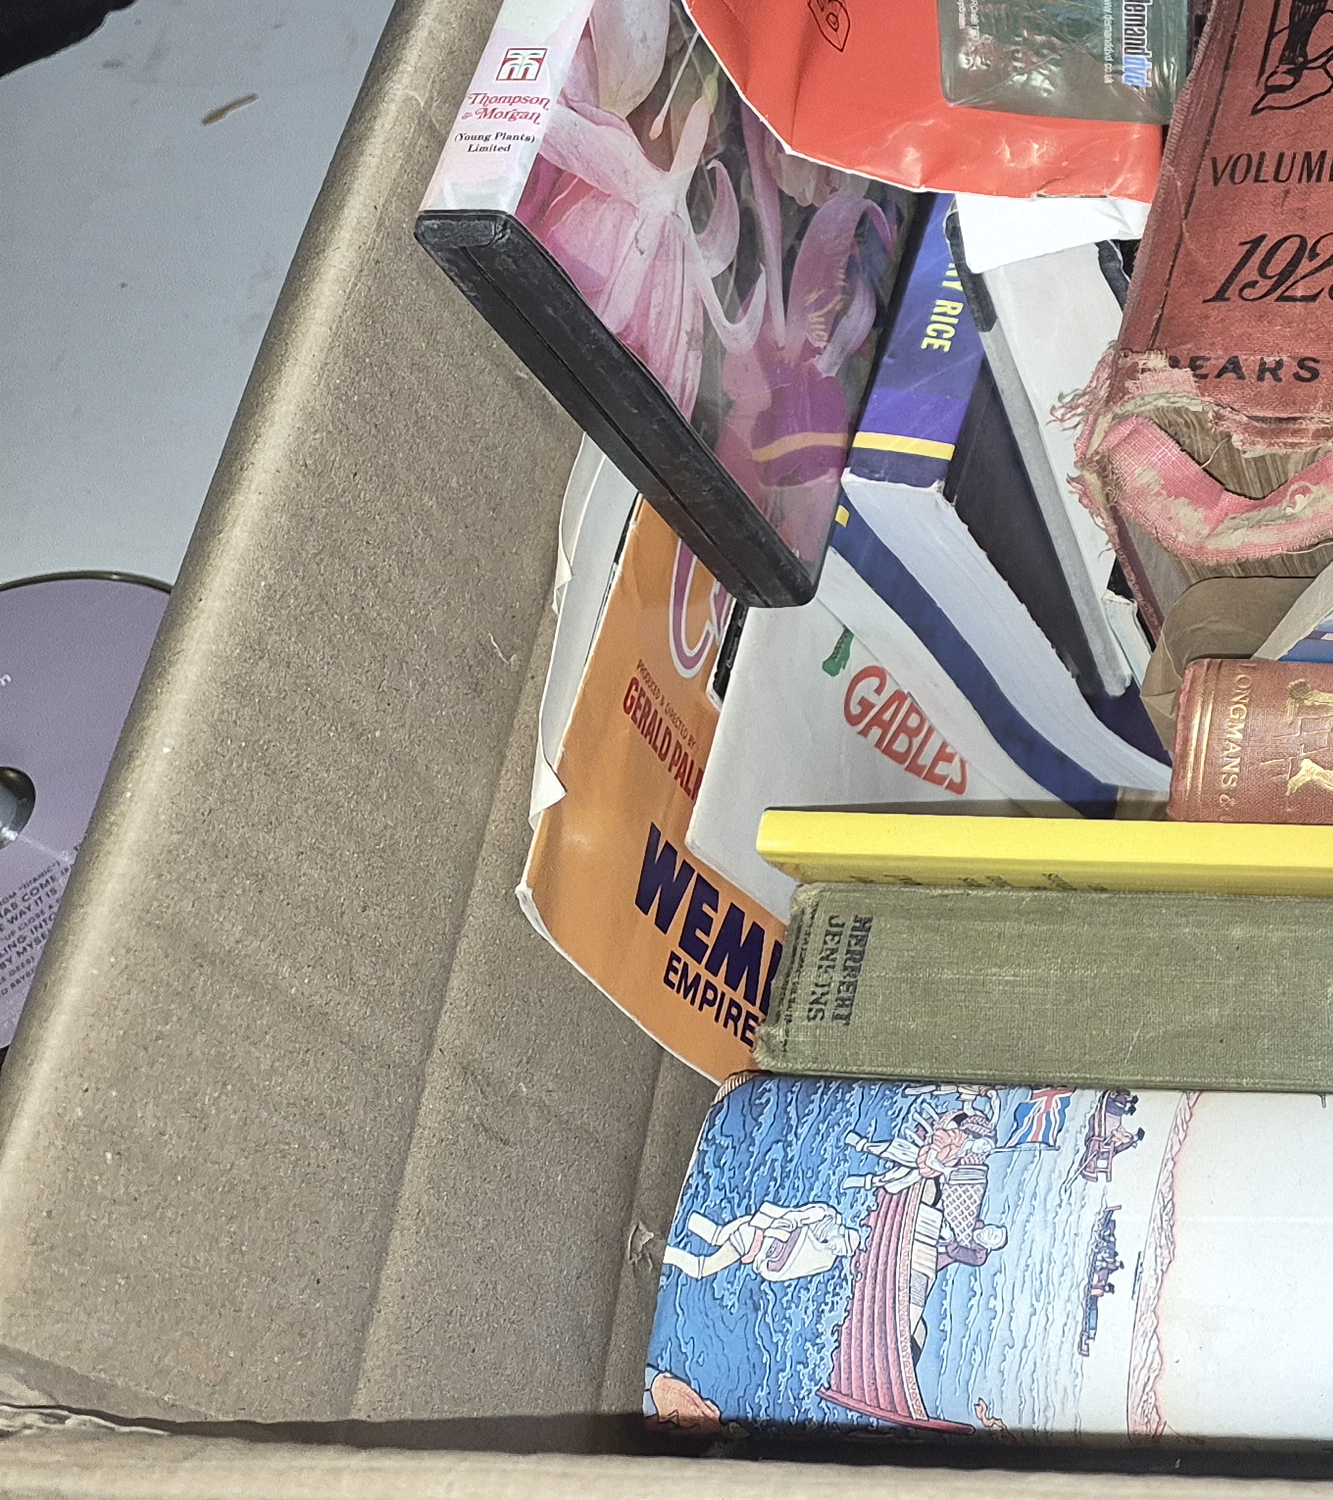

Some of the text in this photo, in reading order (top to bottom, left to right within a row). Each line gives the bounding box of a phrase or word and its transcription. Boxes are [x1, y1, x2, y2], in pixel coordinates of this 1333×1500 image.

[467, 91, 551, 113] Thompson
[474, 106, 543, 125] Morgan
[453, 130, 536, 145] (Young Plants)
[467, 142, 512, 154] Limited
[919, 295, 964, 356] RICE
[623, 676, 672, 761] GERALD
[843, 665, 968, 795] GABLES
[1220, 663, 1257, 790] LONGMANS
[22, 875, 57, 903] COME
[7, 904, 32, 925] WAY
[807, 914, 846, 1023] JENKINS
